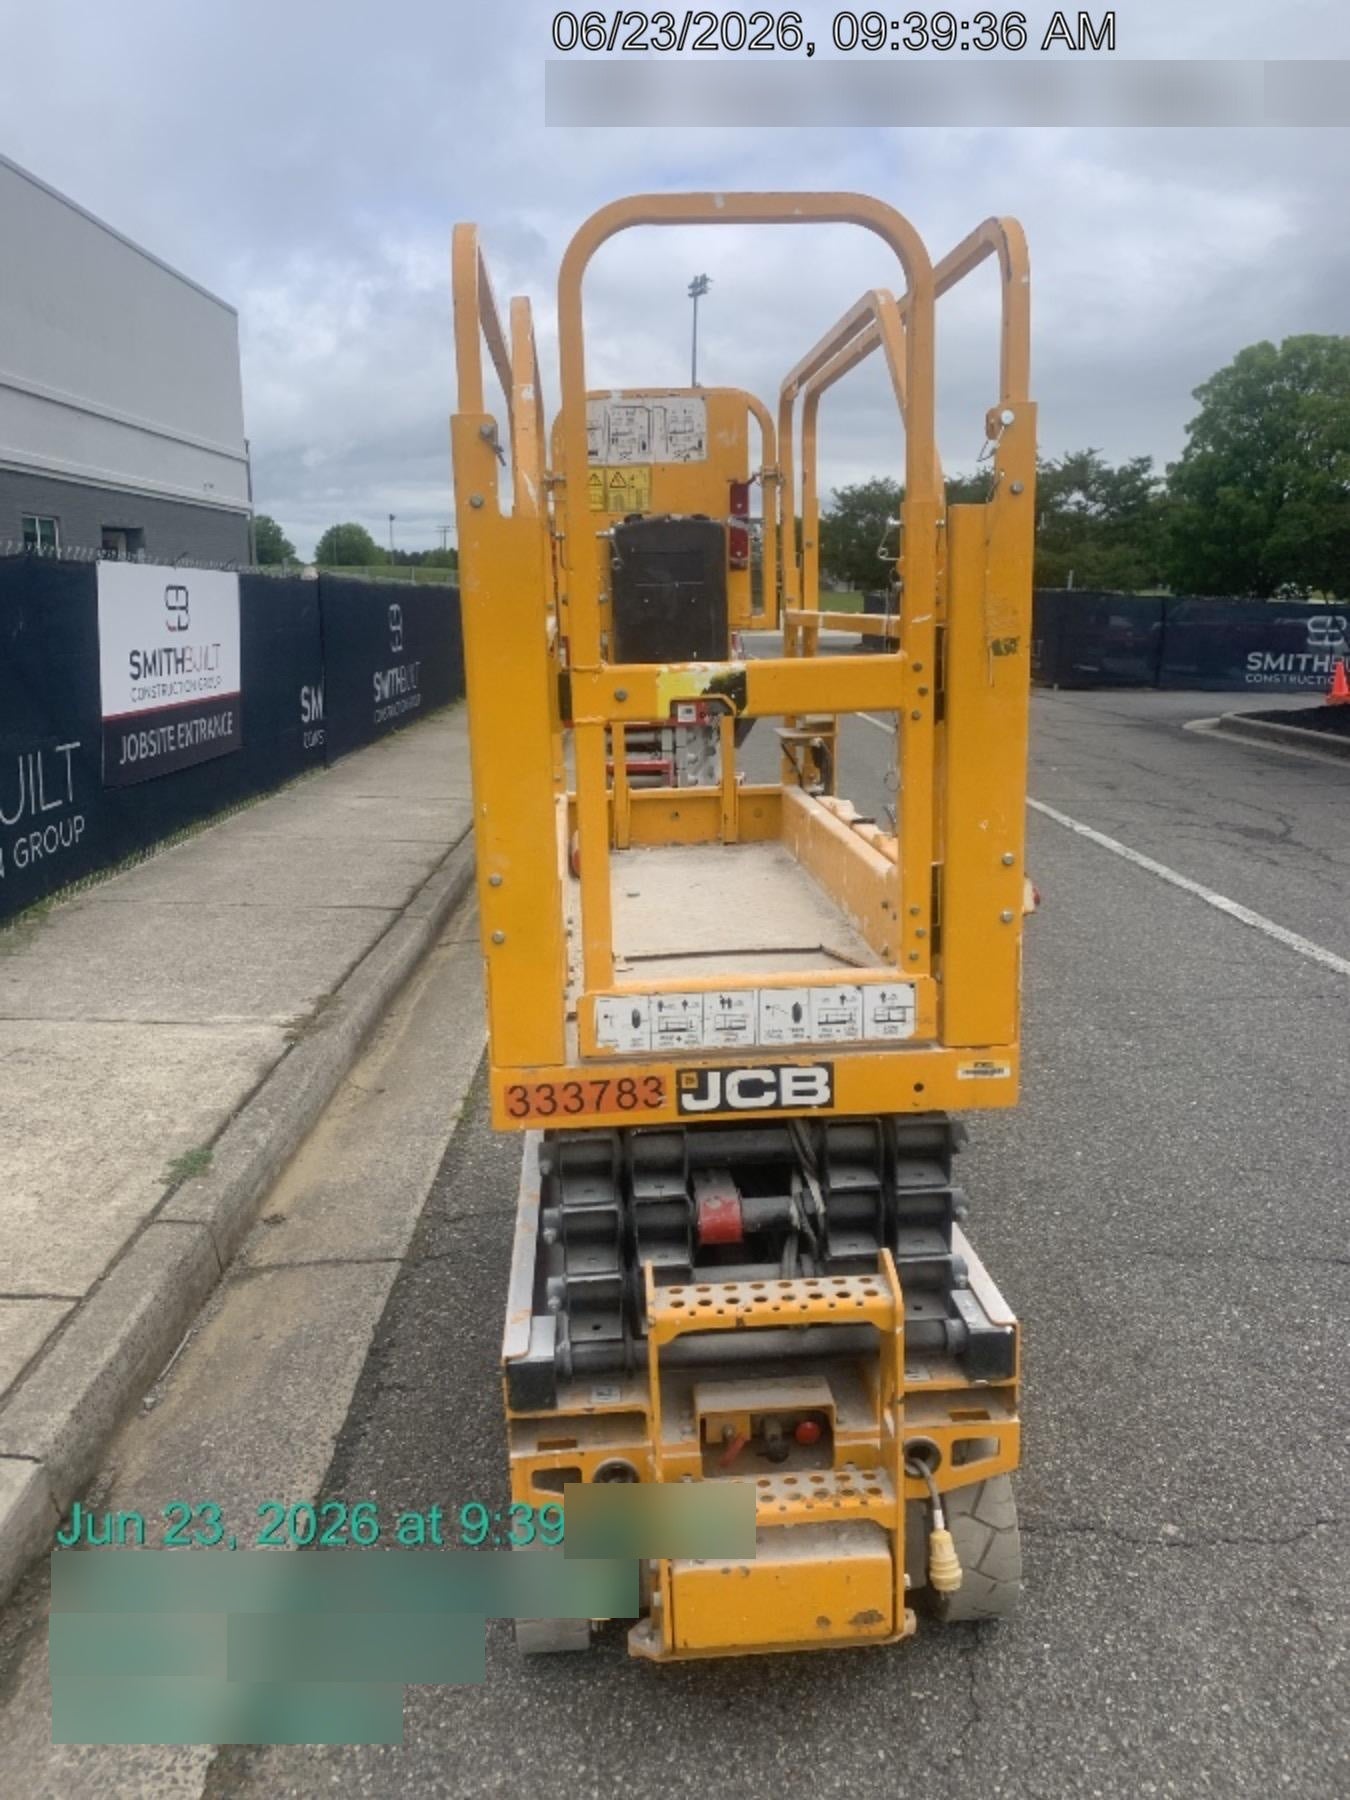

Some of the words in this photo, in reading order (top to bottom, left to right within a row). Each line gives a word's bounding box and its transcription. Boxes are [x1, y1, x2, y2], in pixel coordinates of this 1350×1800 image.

[129, 643, 221, 680] SMITHBUILT
[119, 725, 176, 765] JOBSITE
[13, 815, 85, 868] GROUP
[508, 1076, 664, 1117] 333783
[682, 1067, 831, 1111] JCB
